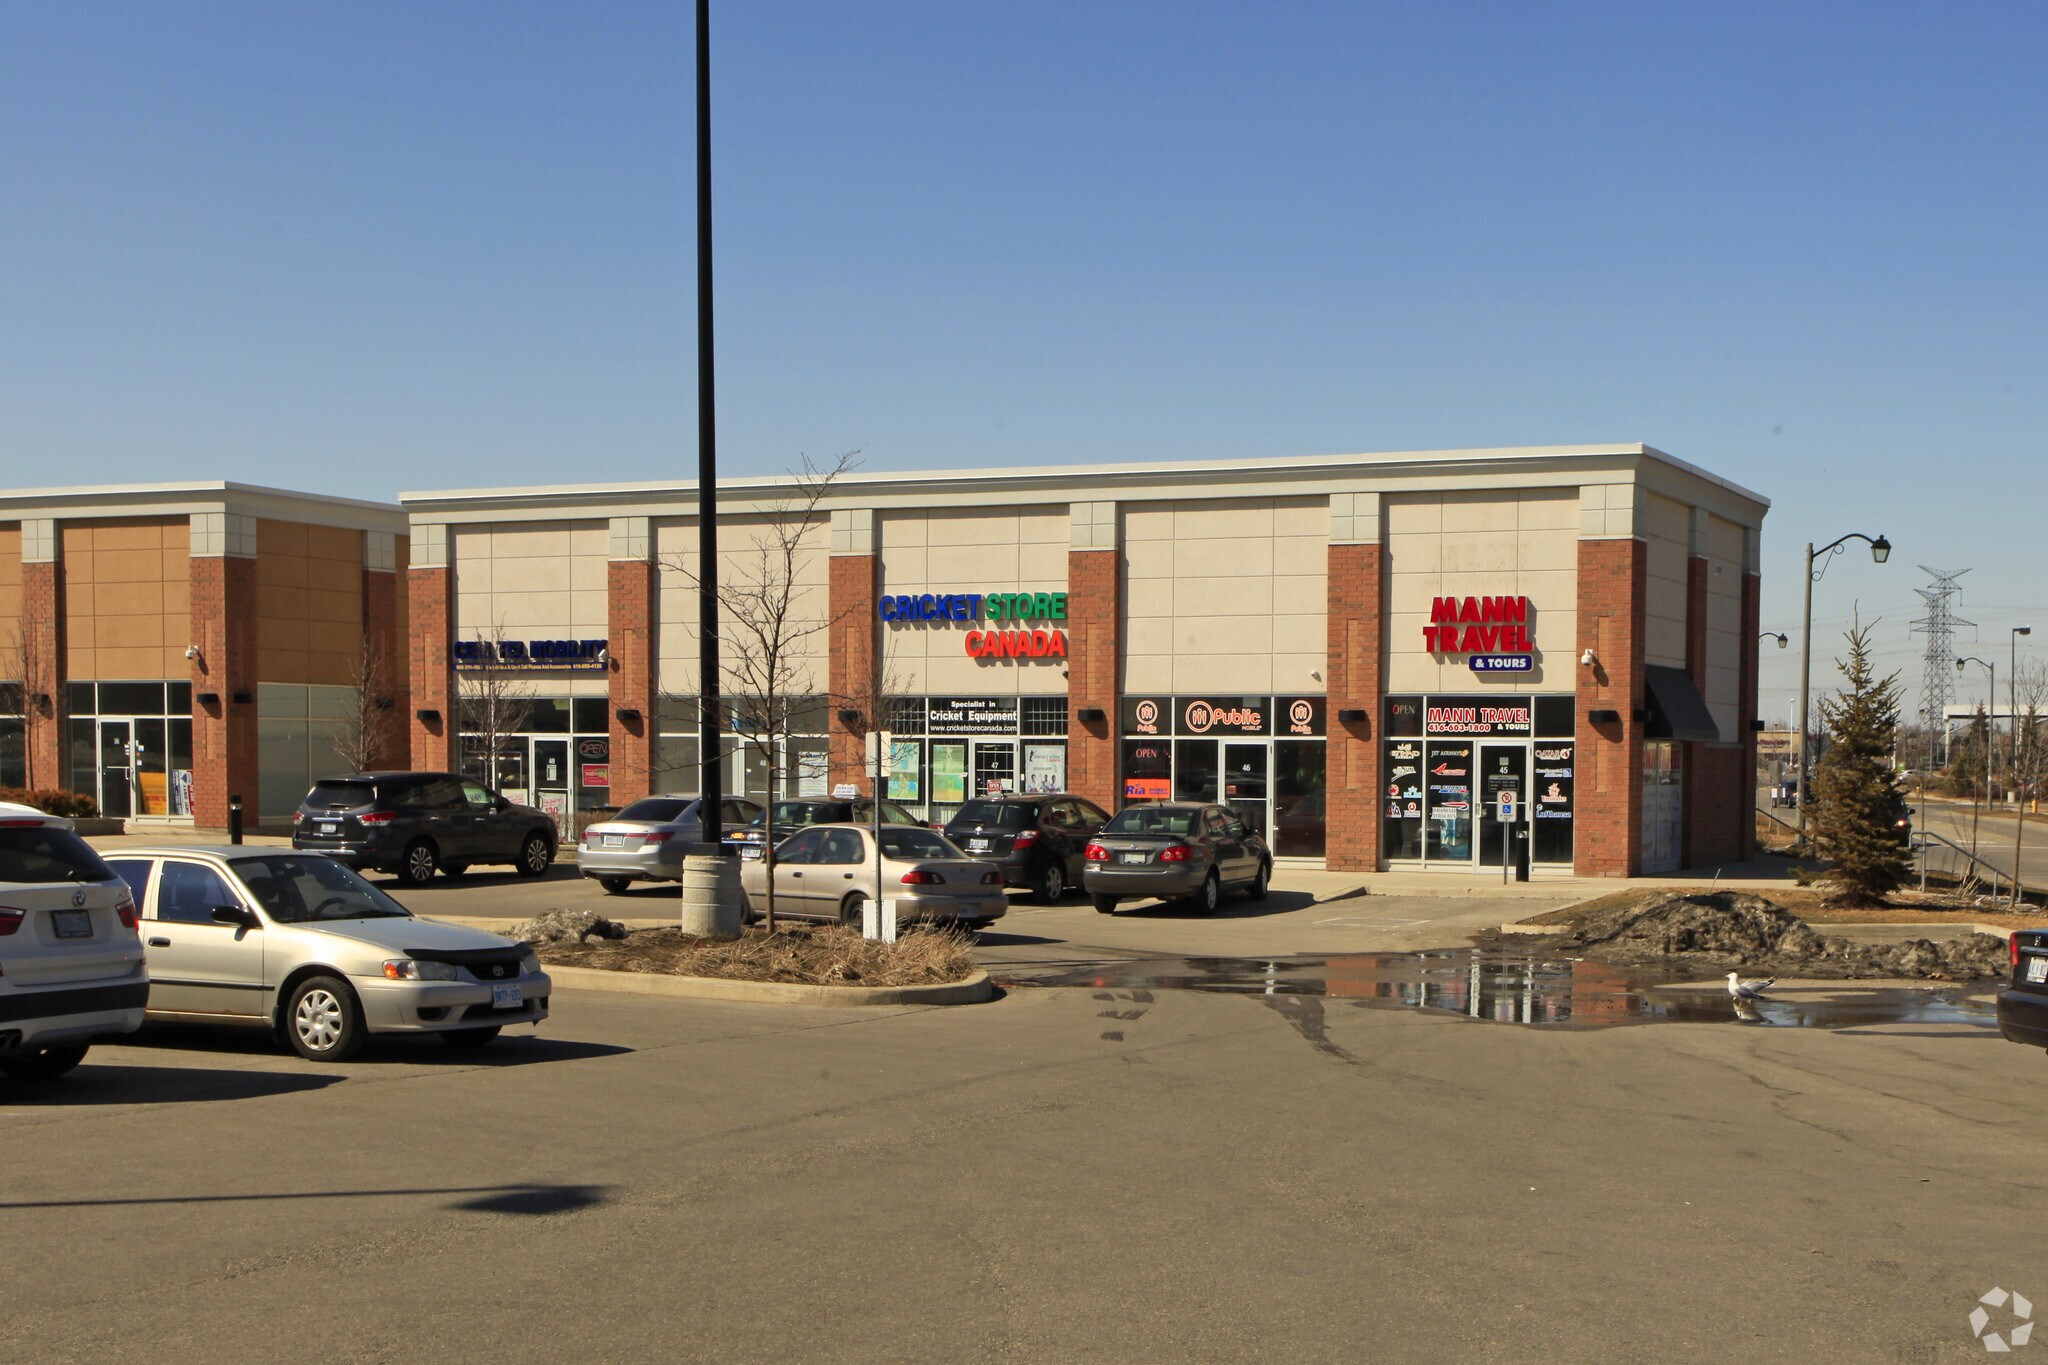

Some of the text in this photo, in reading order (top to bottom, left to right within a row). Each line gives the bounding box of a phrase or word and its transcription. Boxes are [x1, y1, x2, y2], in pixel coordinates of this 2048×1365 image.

[879, 592, 1066, 621] CRICKET STORE
[1430, 596, 1527, 623] MANN
[965, 629, 1066, 657] CANADA
[1423, 625, 1534, 653] TRAVEL
[529, 640, 608, 658] MOBILITY
[1475, 658, 1527, 668] & TOURS
[951, 701, 986, 709] Specialist
[1392, 704, 1415, 715] OPEN
[930, 710, 1017, 723] Cricket Equipment
[1213, 708, 1261, 725] Public
[1428, 707, 1529, 723] MANN TRAVEL
[1428, 723, 1491, 733] 416-603-1800
[582, 743, 607, 753] OPEN
[1136, 748, 1157, 758] OPEN
[1126, 784, 1145, 795] Ria
